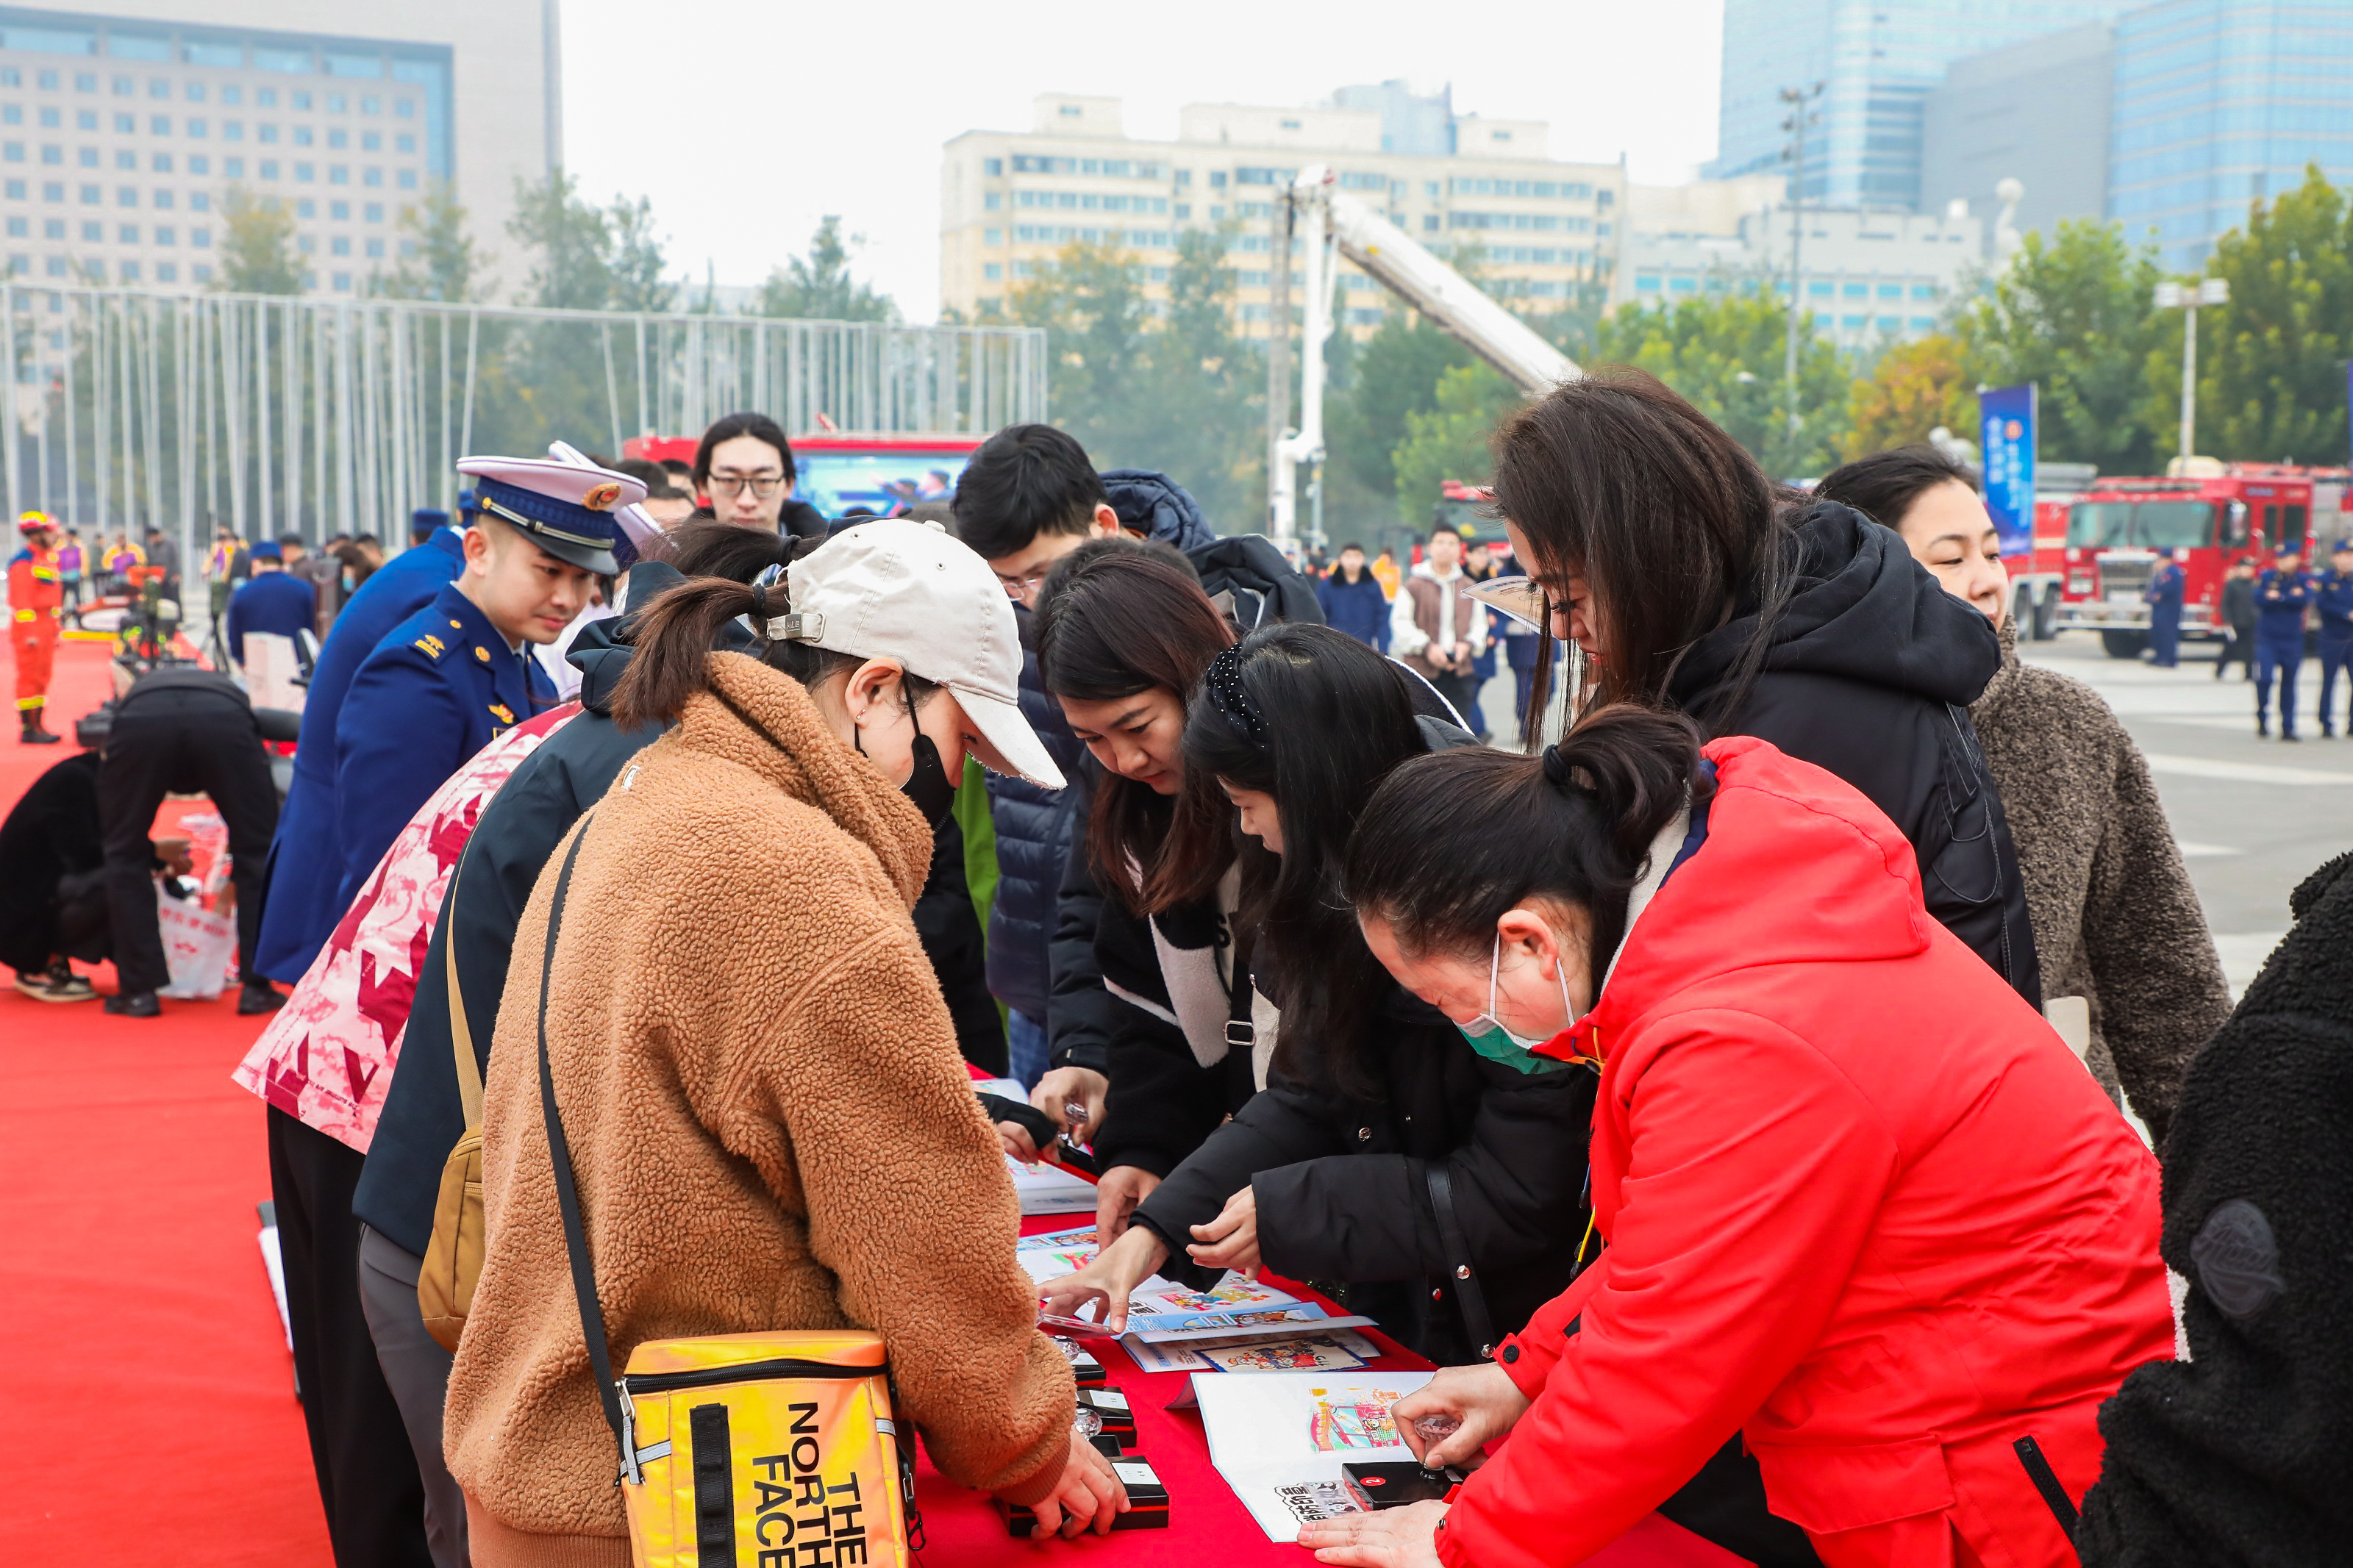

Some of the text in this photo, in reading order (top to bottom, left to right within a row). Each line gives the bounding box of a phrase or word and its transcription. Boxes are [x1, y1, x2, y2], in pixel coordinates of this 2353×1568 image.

[752, 1454, 796, 1568] FACE
[788, 1403, 834, 1568] NORTH
[827, 1472, 868, 1568] THE
